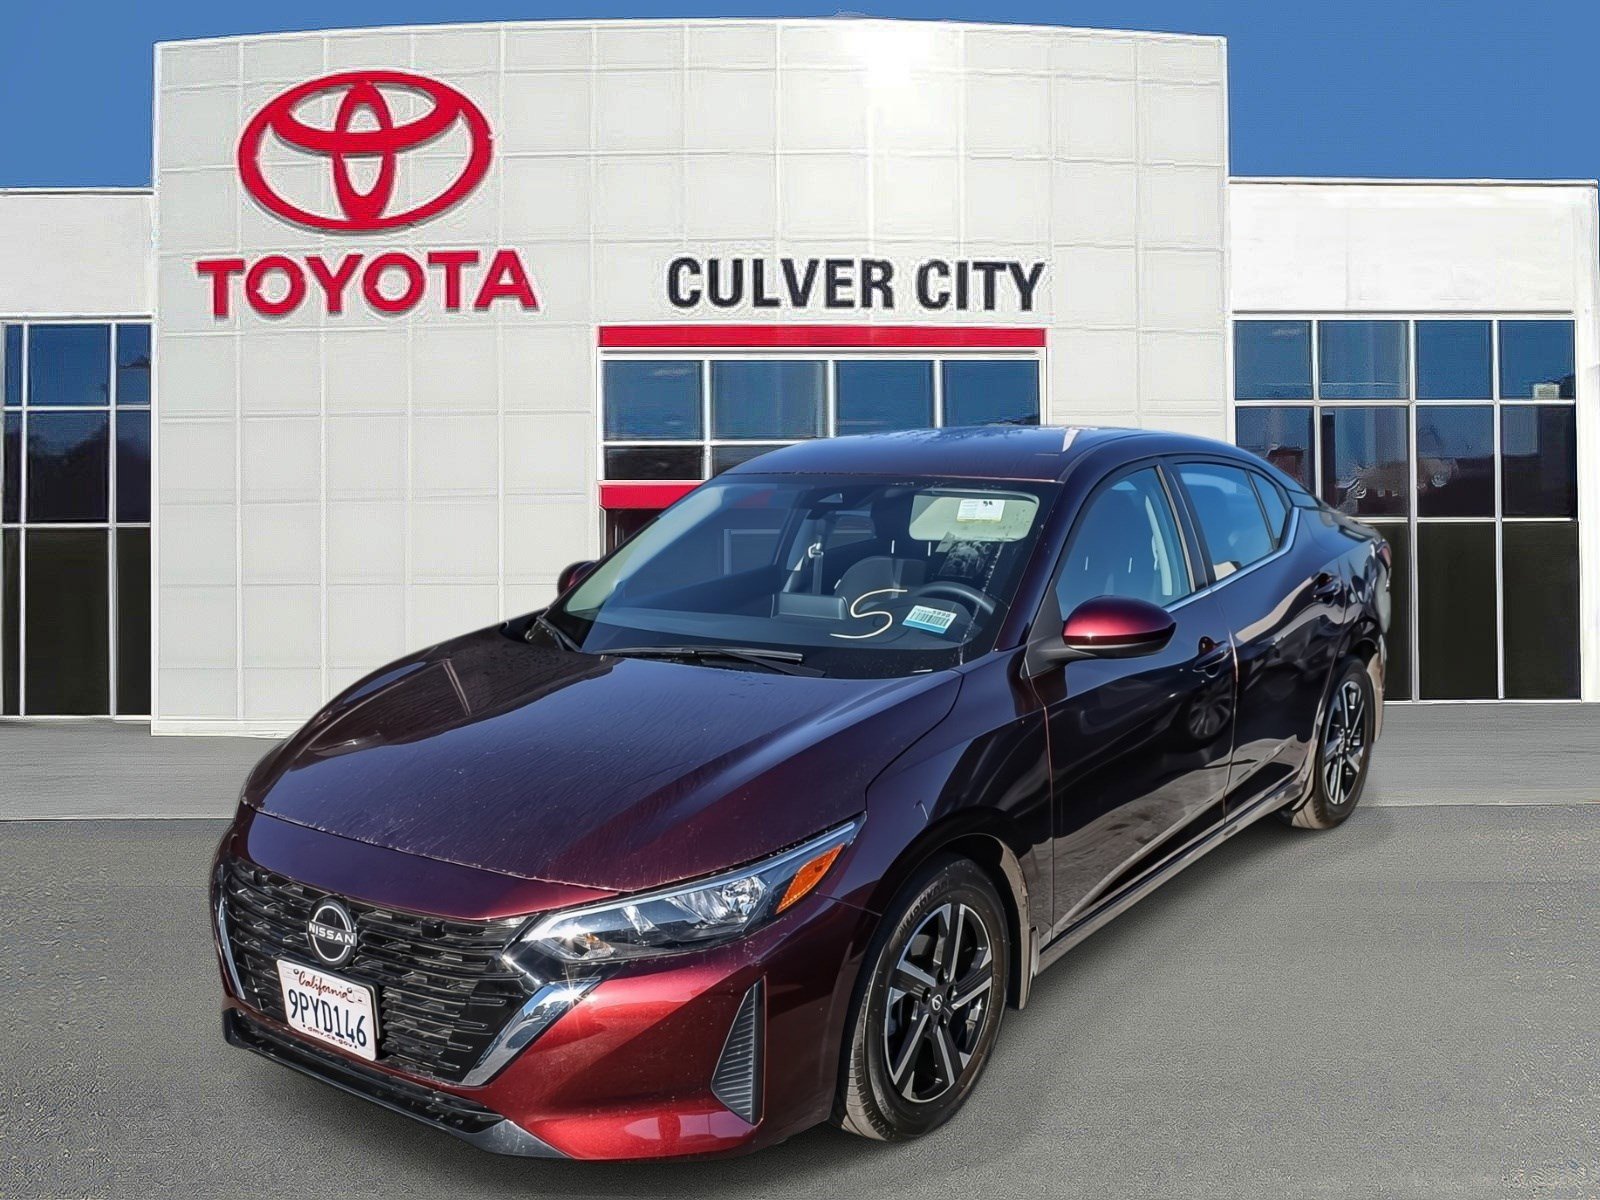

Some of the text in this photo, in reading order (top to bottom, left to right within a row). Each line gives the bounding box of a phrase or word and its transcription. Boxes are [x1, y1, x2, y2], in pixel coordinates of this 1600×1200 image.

[195, 249, 539, 318] TOYOTA
[667, 257, 1046, 312] CULVER CITY
[308, 922, 355, 945] NISSAN
[297, 970, 354, 1003] California
[288, 988, 367, 1047] 9PYD146
